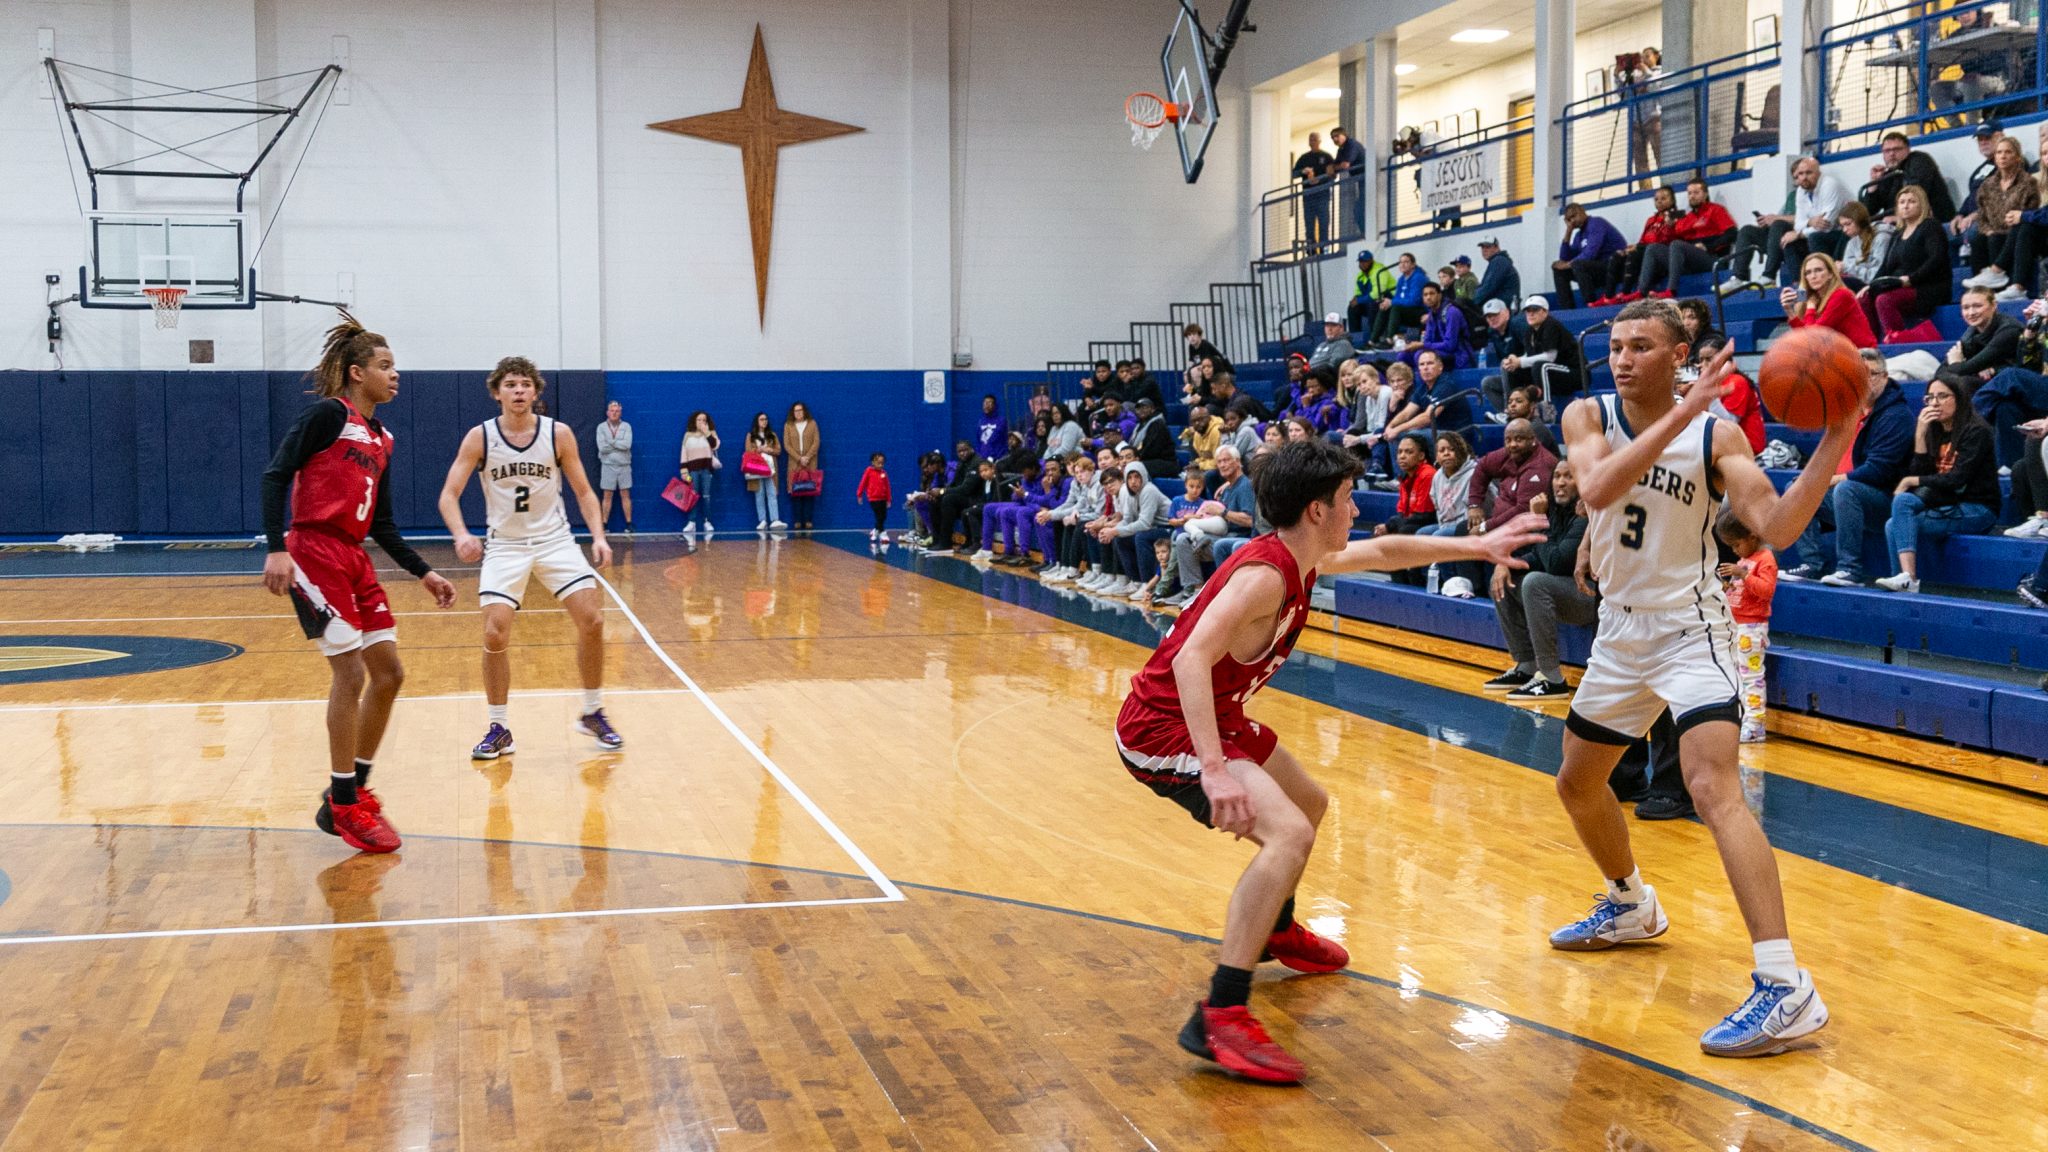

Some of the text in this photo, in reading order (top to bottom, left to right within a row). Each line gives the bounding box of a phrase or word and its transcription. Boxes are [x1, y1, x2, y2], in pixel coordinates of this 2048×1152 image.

[1436, 151, 1483, 188] JESUIT
[1427, 178, 1494, 208] STUDENT SECTION
[490, 461, 552, 481] RANGERS
[356, 475, 374, 522] 3
[514, 485, 530, 513] 2
[1620, 502, 1647, 551] 3
